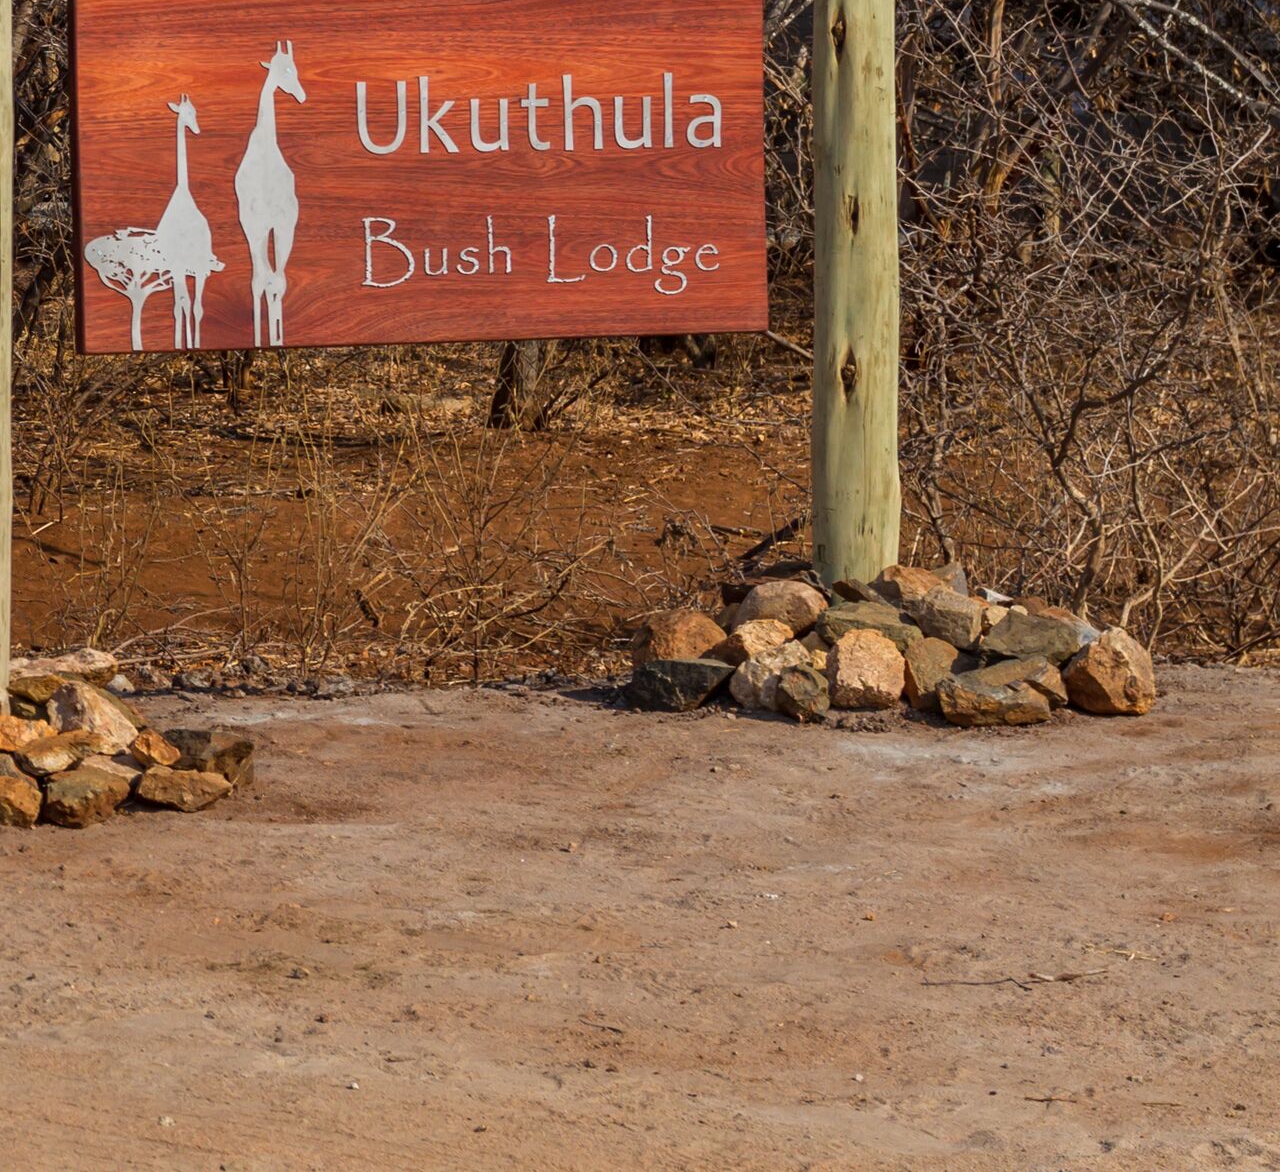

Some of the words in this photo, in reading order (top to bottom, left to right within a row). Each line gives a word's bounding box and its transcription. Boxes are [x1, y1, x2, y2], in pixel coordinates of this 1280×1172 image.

[356, 73, 722, 154] Ukuthula
[361, 216, 513, 288] Bush
[547, 214, 720, 295] Lodge
